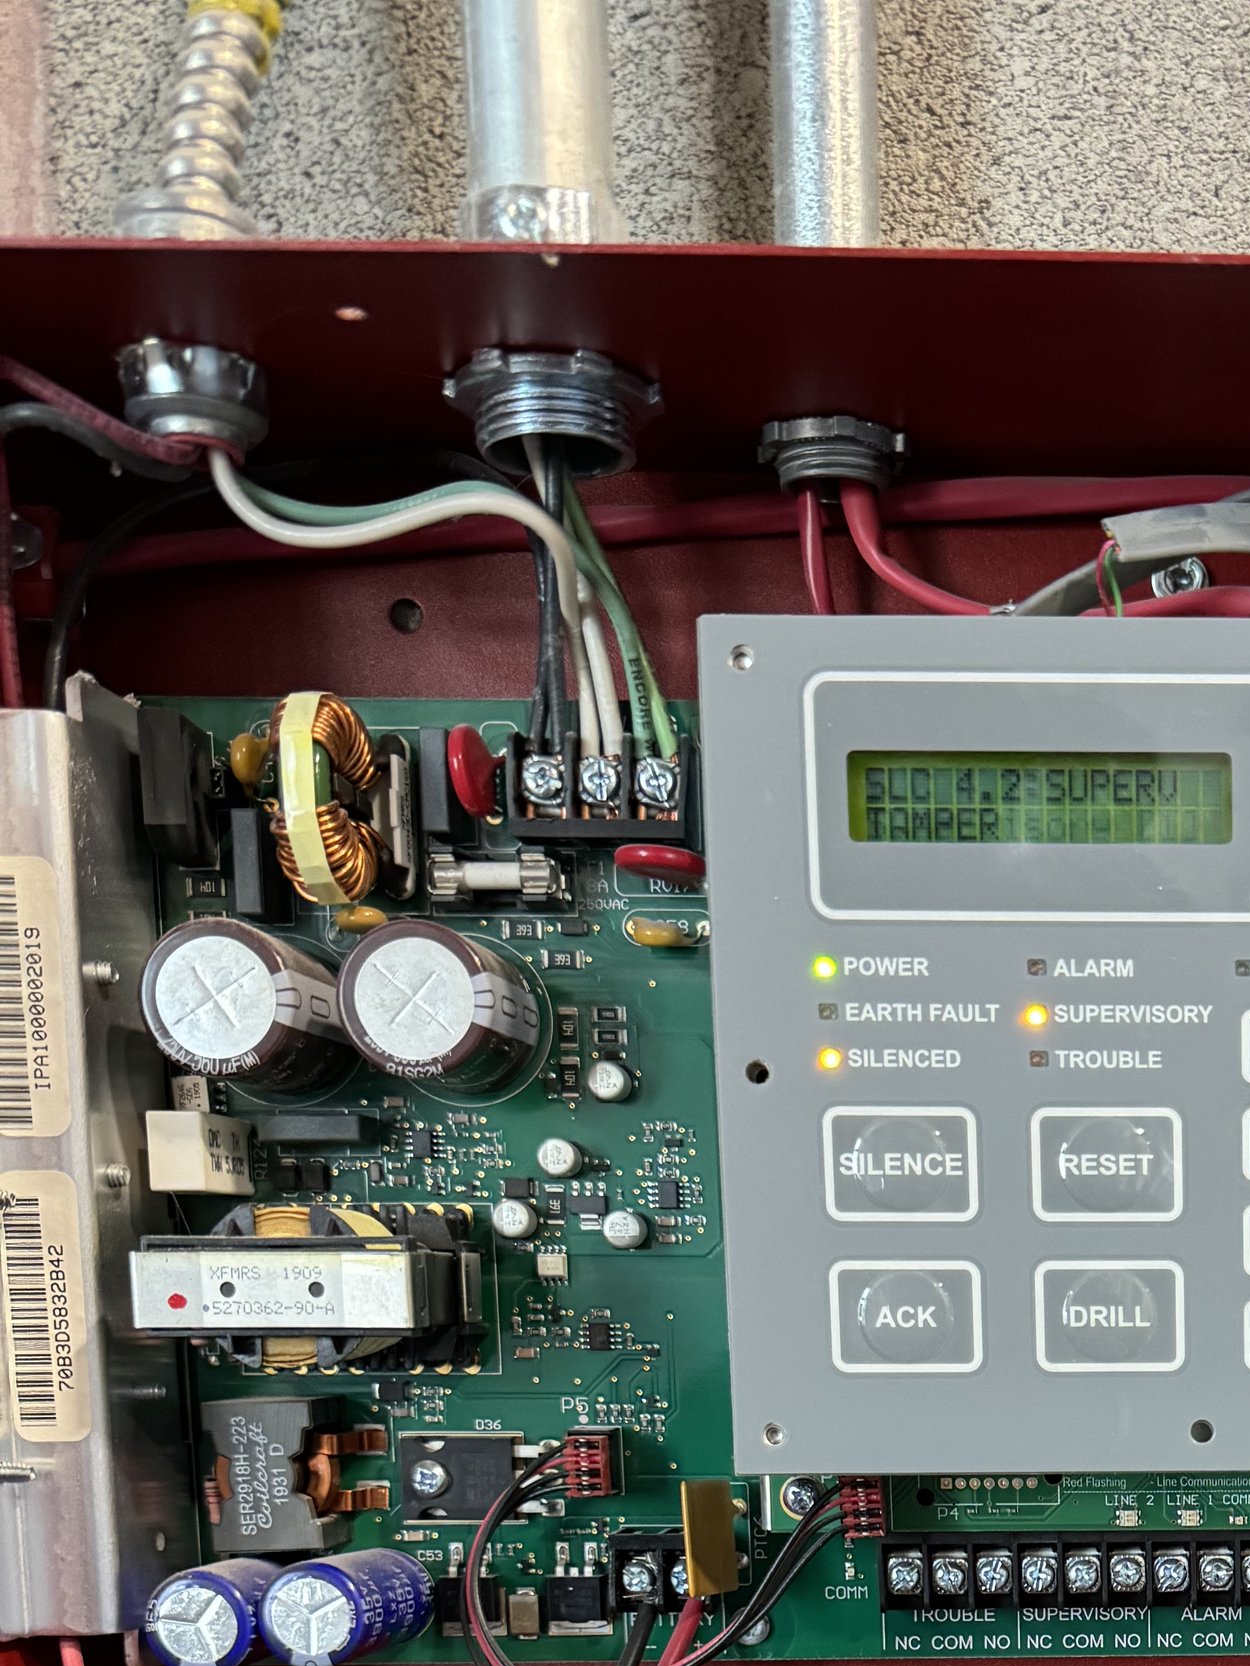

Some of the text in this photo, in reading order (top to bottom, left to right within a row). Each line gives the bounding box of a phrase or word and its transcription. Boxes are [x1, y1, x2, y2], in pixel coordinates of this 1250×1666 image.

[865, 767, 930, 803] SLC
[865, 807, 1000, 842] TAMPER
[843, 957, 930, 977] POWER
[1053, 958, 1135, 978] ALARM
[23, 927, 51, 1090] IPA1000002019
[845, 1003, 1001, 1023] EARTH FAULT
[1054, 1004, 1213, 1024] SUPERVISORY
[847, 1049, 962, 1069] SILENCED
[1055, 1050, 1163, 1069] TROUBLE
[838, 1152, 964, 1177] SILENCE
[1062, 1153, 1154, 1177] RESET
[283, 1265, 323, 1281] 1909
[47, 1244, 76, 1392] 70B3D5832B42
[211, 1300, 336, 1317] 5270362-90-A
[875, 1305, 938, 1328] ACK
[1068, 1305, 1151, 1328] DRILL
[561, 1396, 589, 1414] P5
[475, 1418, 502, 1431] D36
[230, 1415, 258, 1536] SER2918H-223
[249, 1421, 273, 1530] Coilcraft
[269, 1443, 289, 1506] 1931 D
[1062, 1477, 1083, 1488] Red
[1085, 1477, 1127, 1490] Flashing
[1156, 1476, 1177, 1487] Line
[1104, 1495, 1155, 1506] LINE 2
[1167, 1495, 1200, 1506] LINE
[937, 1507, 960, 1521] P4
[417, 1550, 444, 1561] C53
[824, 1585, 869, 1600] COMM
[1022, 1606, 1149, 1622] SUPERVISORY
[1181, 1606, 1243, 1621] ALARM
[895, 1634, 1011, 1650] NC COM NO
[1026, 1633, 1141, 1649] NC COM NO
[1156, 1633, 1183, 1648] NC
[1192, 1632, 1234, 1648] COM
